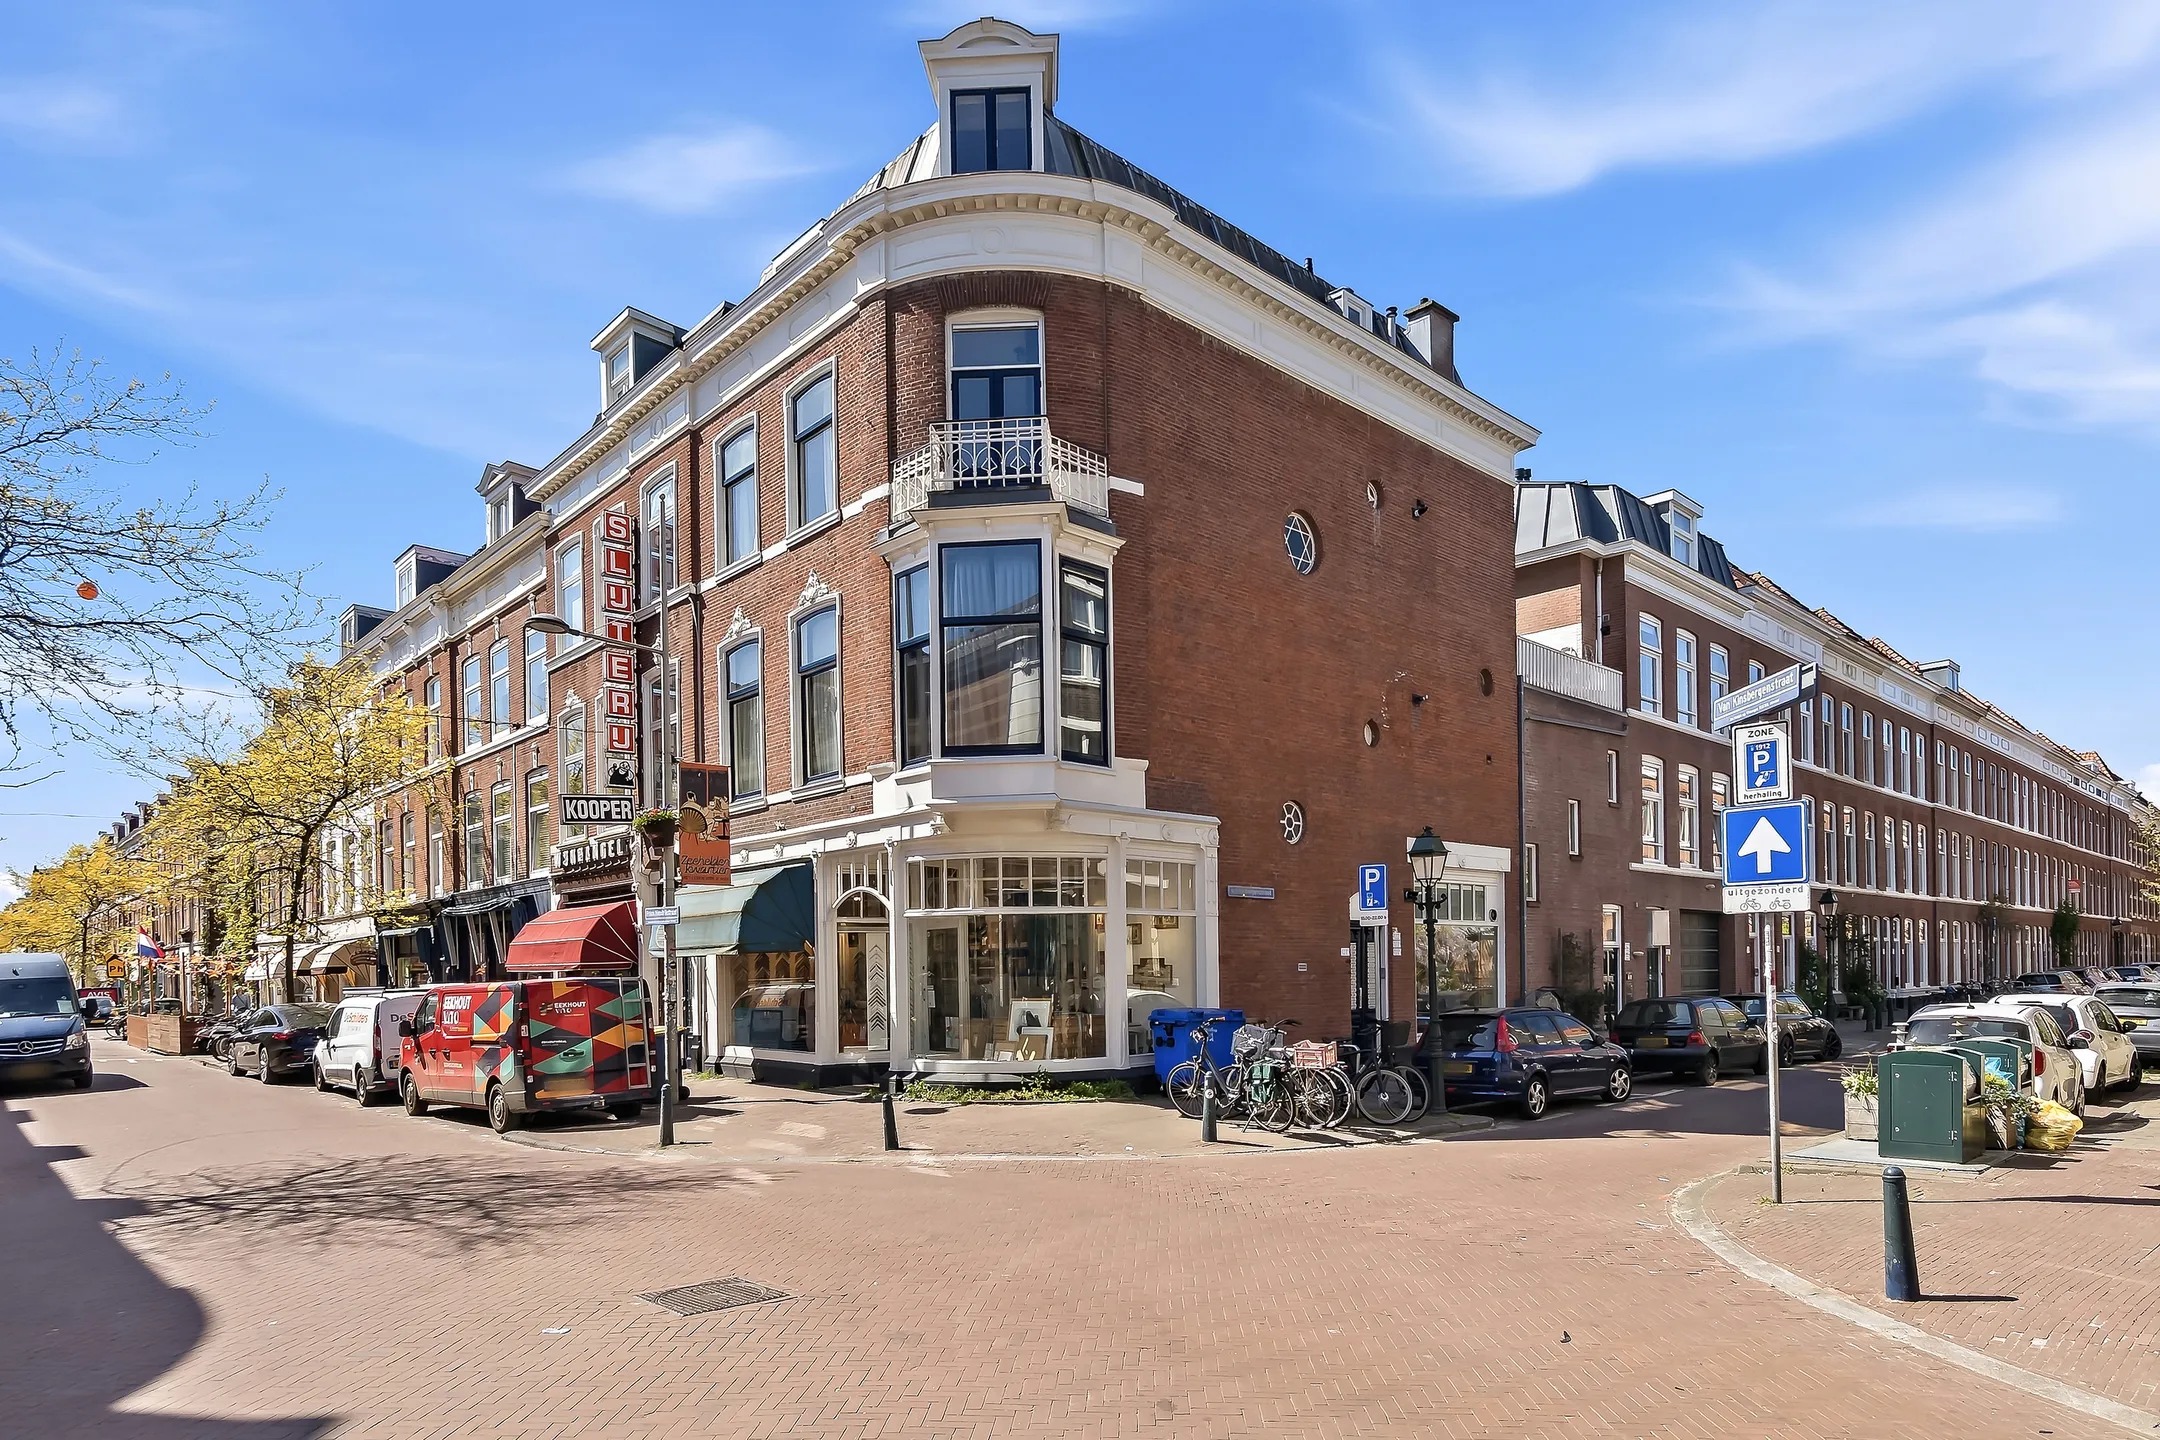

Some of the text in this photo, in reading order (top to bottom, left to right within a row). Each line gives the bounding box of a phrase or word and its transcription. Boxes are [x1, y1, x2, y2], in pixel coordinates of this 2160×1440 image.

[1717, 701, 1731, 713] Van
[1732, 671, 1795, 708] Kinsbergenstraat
[1748, 727, 1775, 738] ZONE
[1755, 742, 1771, 751] 1912
[1753, 750, 1770, 773] P
[1743, 790, 1782, 800] herhaling
[565, 799, 633, 820] KOOPER
[1365, 868, 1381, 891] P
[1727, 885, 1804, 897] uitgezonderd
[443, 995, 472, 1010] EEKHOUT
[554, 1001, 586, 1009] EEKHOUT
